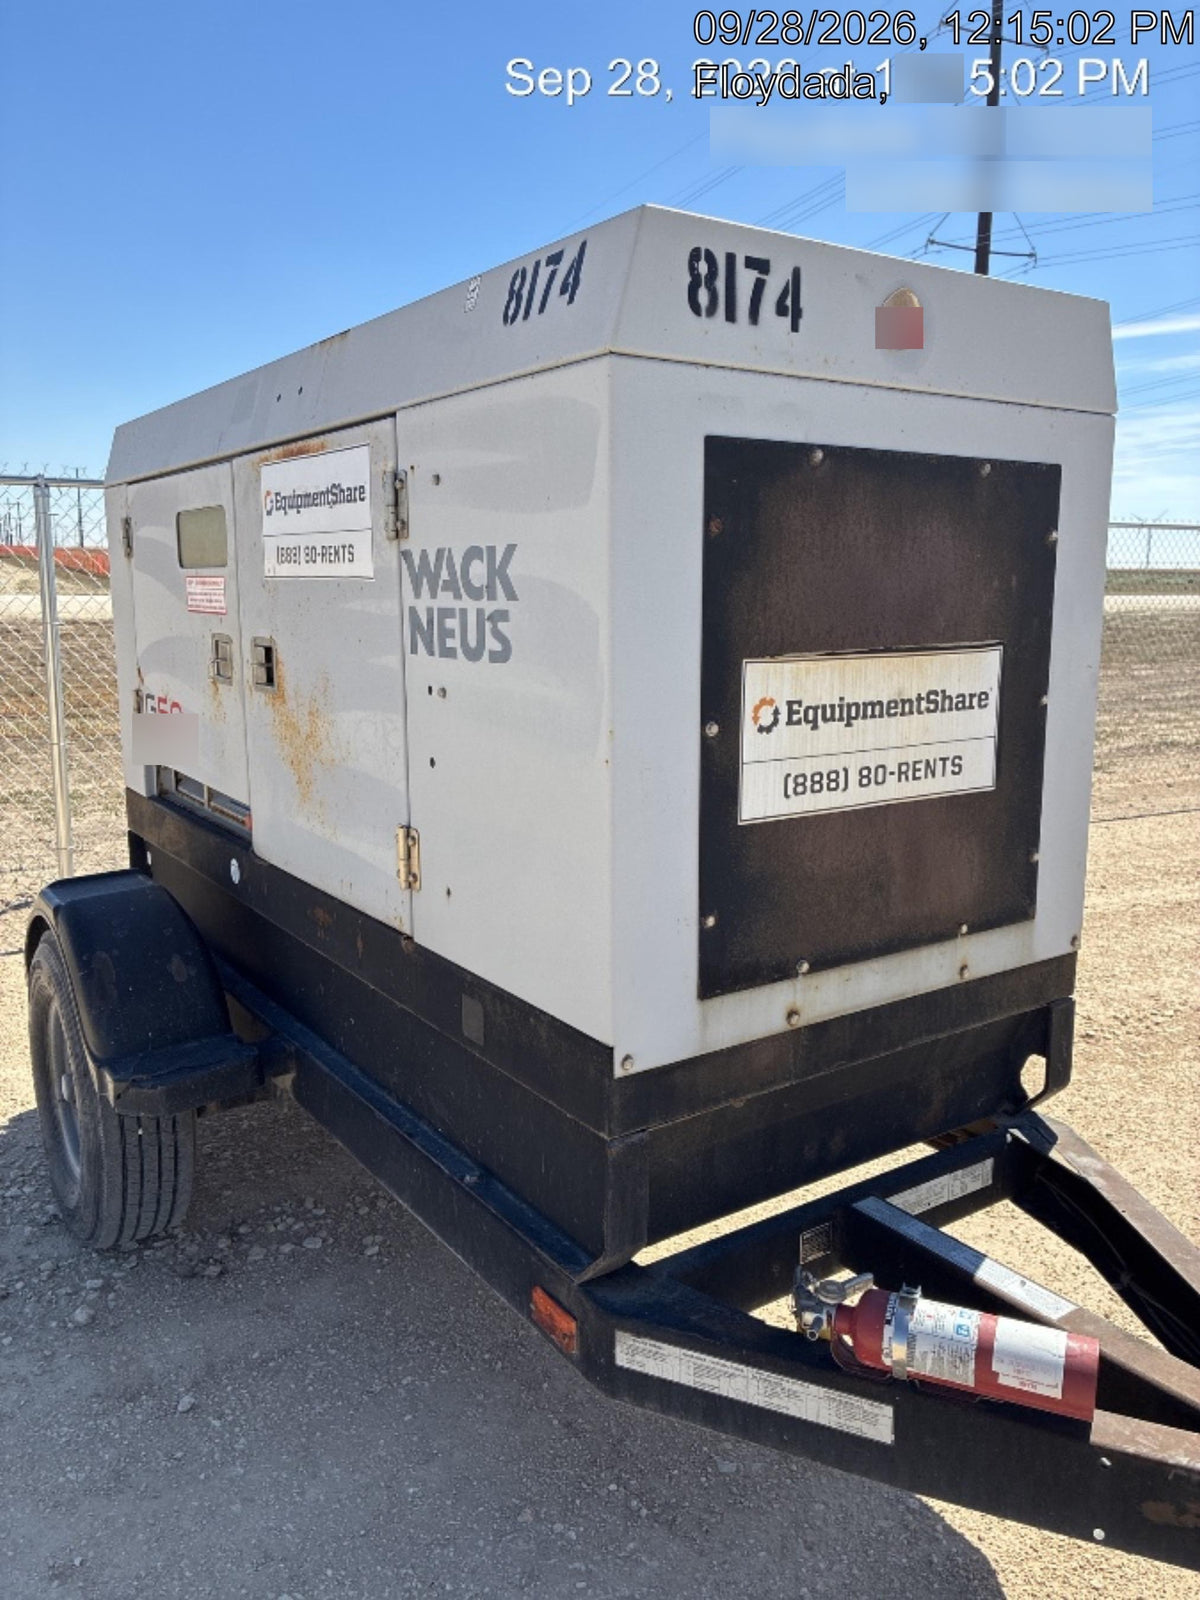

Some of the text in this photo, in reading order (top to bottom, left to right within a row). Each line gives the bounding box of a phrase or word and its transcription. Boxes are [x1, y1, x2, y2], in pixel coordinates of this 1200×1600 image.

[502, 240, 587, 326] 8174
[687, 246, 803, 333] 8174
[274, 483, 366, 516] EquipmentShare
[400, 543, 520, 602] WACK
[408, 605, 513, 664] NEUS
[785, 689, 989, 731] EquipmentShare
[783, 755, 963, 799] (888) 80-RENTS
